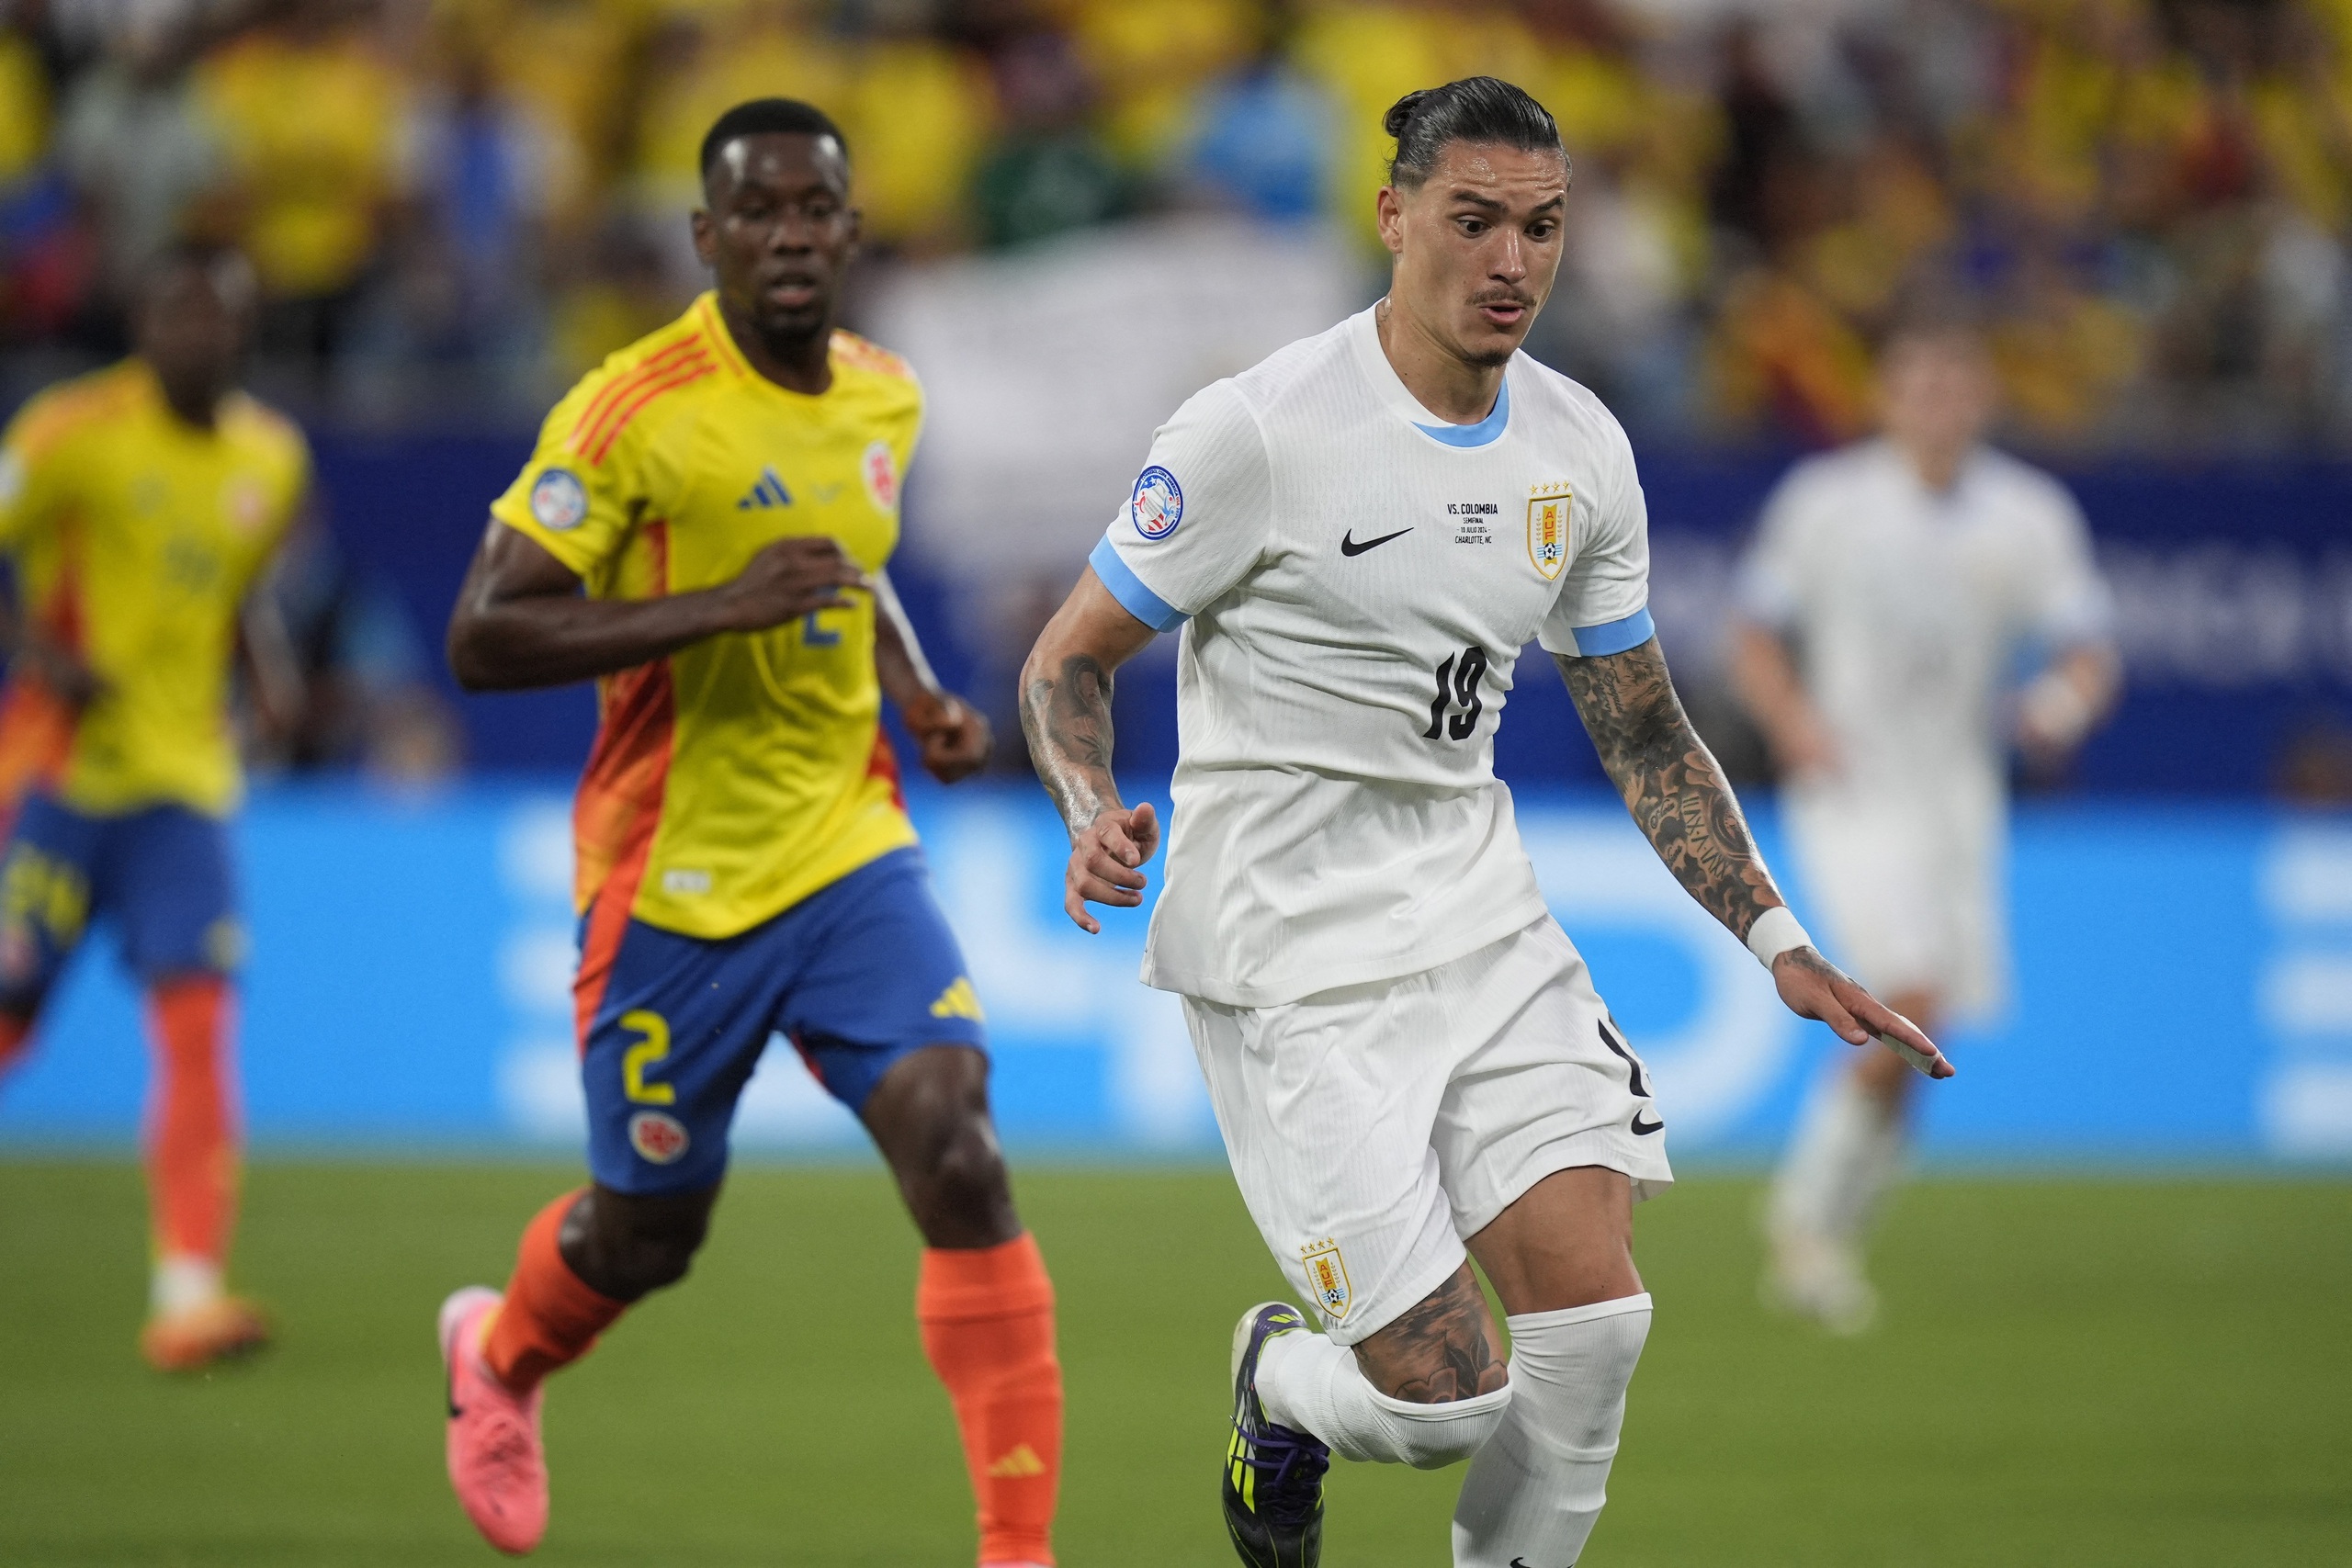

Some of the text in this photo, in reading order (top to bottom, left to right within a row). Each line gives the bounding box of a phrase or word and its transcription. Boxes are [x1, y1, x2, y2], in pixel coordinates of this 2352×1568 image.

[1447, 503, 1498, 514] VS. COLOMBIA
[1544, 511, 1555, 540] AUF
[1454, 536, 1492, 545] CHARLOTTE, NC
[1422, 646, 1487, 740] 19
[618, 1009, 676, 1105] 2
[1320, 1264, 1333, 1288] AUF
